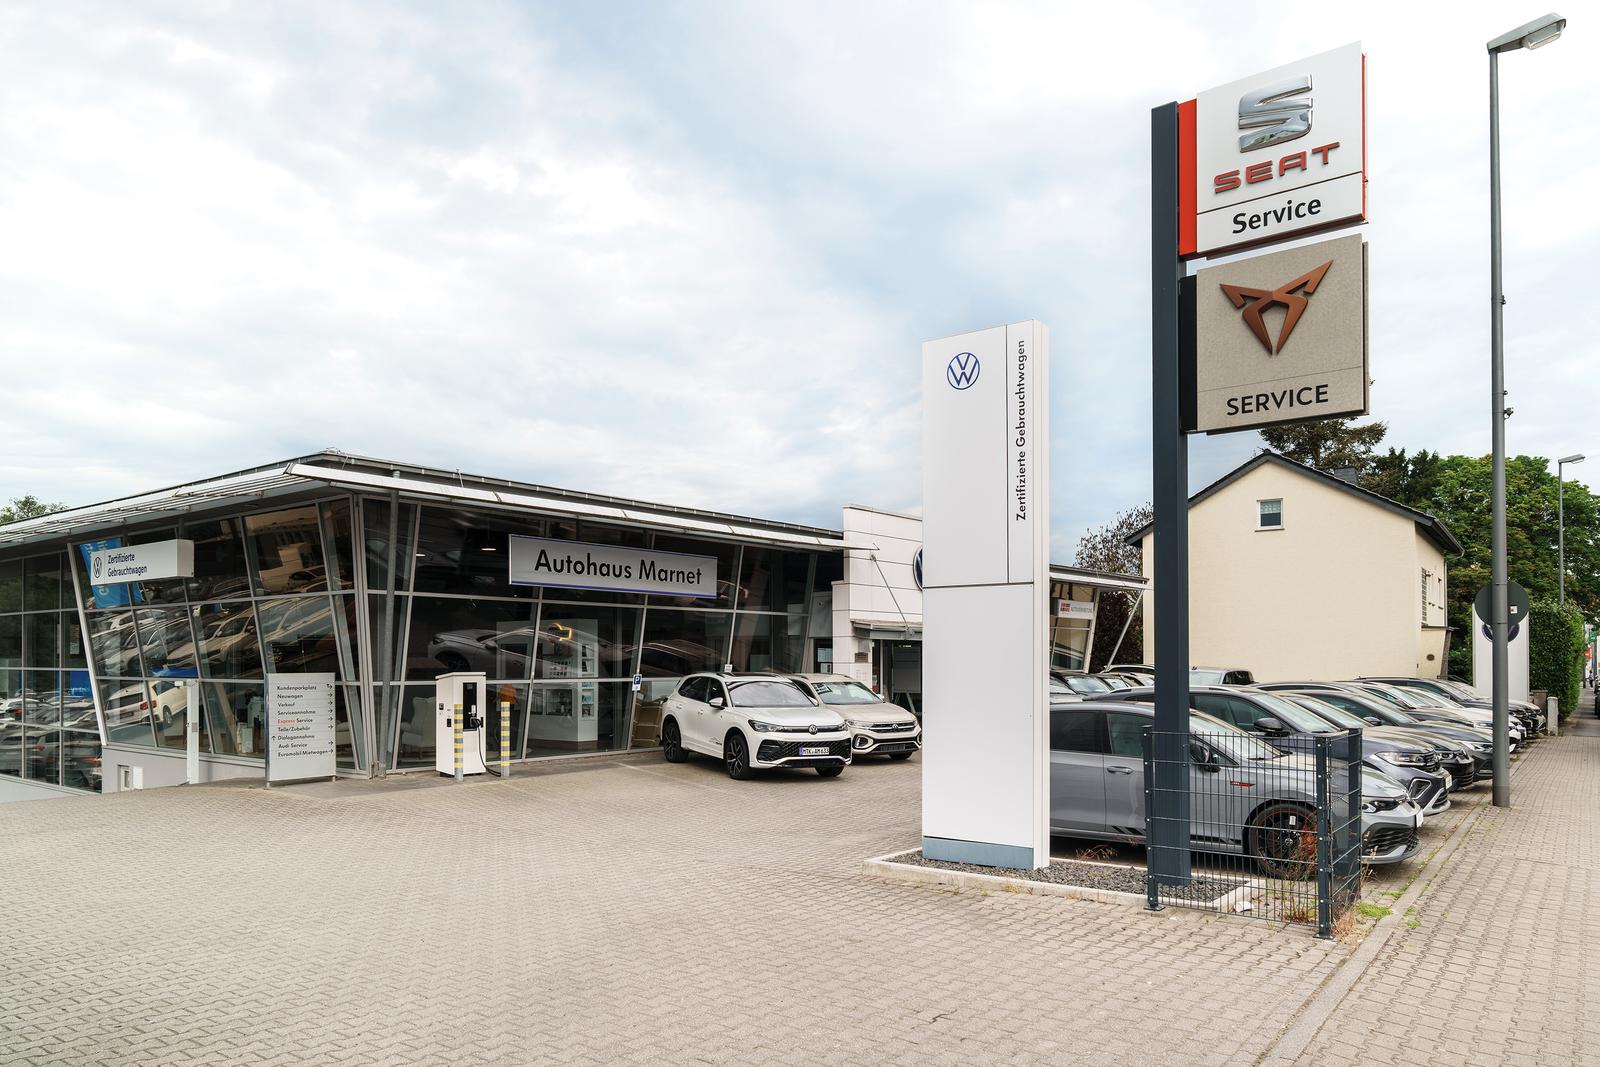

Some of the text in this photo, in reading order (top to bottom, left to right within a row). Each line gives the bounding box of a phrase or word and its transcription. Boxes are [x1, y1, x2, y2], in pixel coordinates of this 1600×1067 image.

[1214, 141, 1340, 193] SEAT
[1232, 198, 1322, 234] Service
[1226, 384, 1329, 416] SERVICE
[1015, 340, 1028, 521] Zertifizierte Gebrauchtwagen
[108, 553, 135, 564] Zertifizierte
[108, 566, 147, 577] Gebrauchtwagen
[534, 549, 702, 585] Autohaus Marnet
